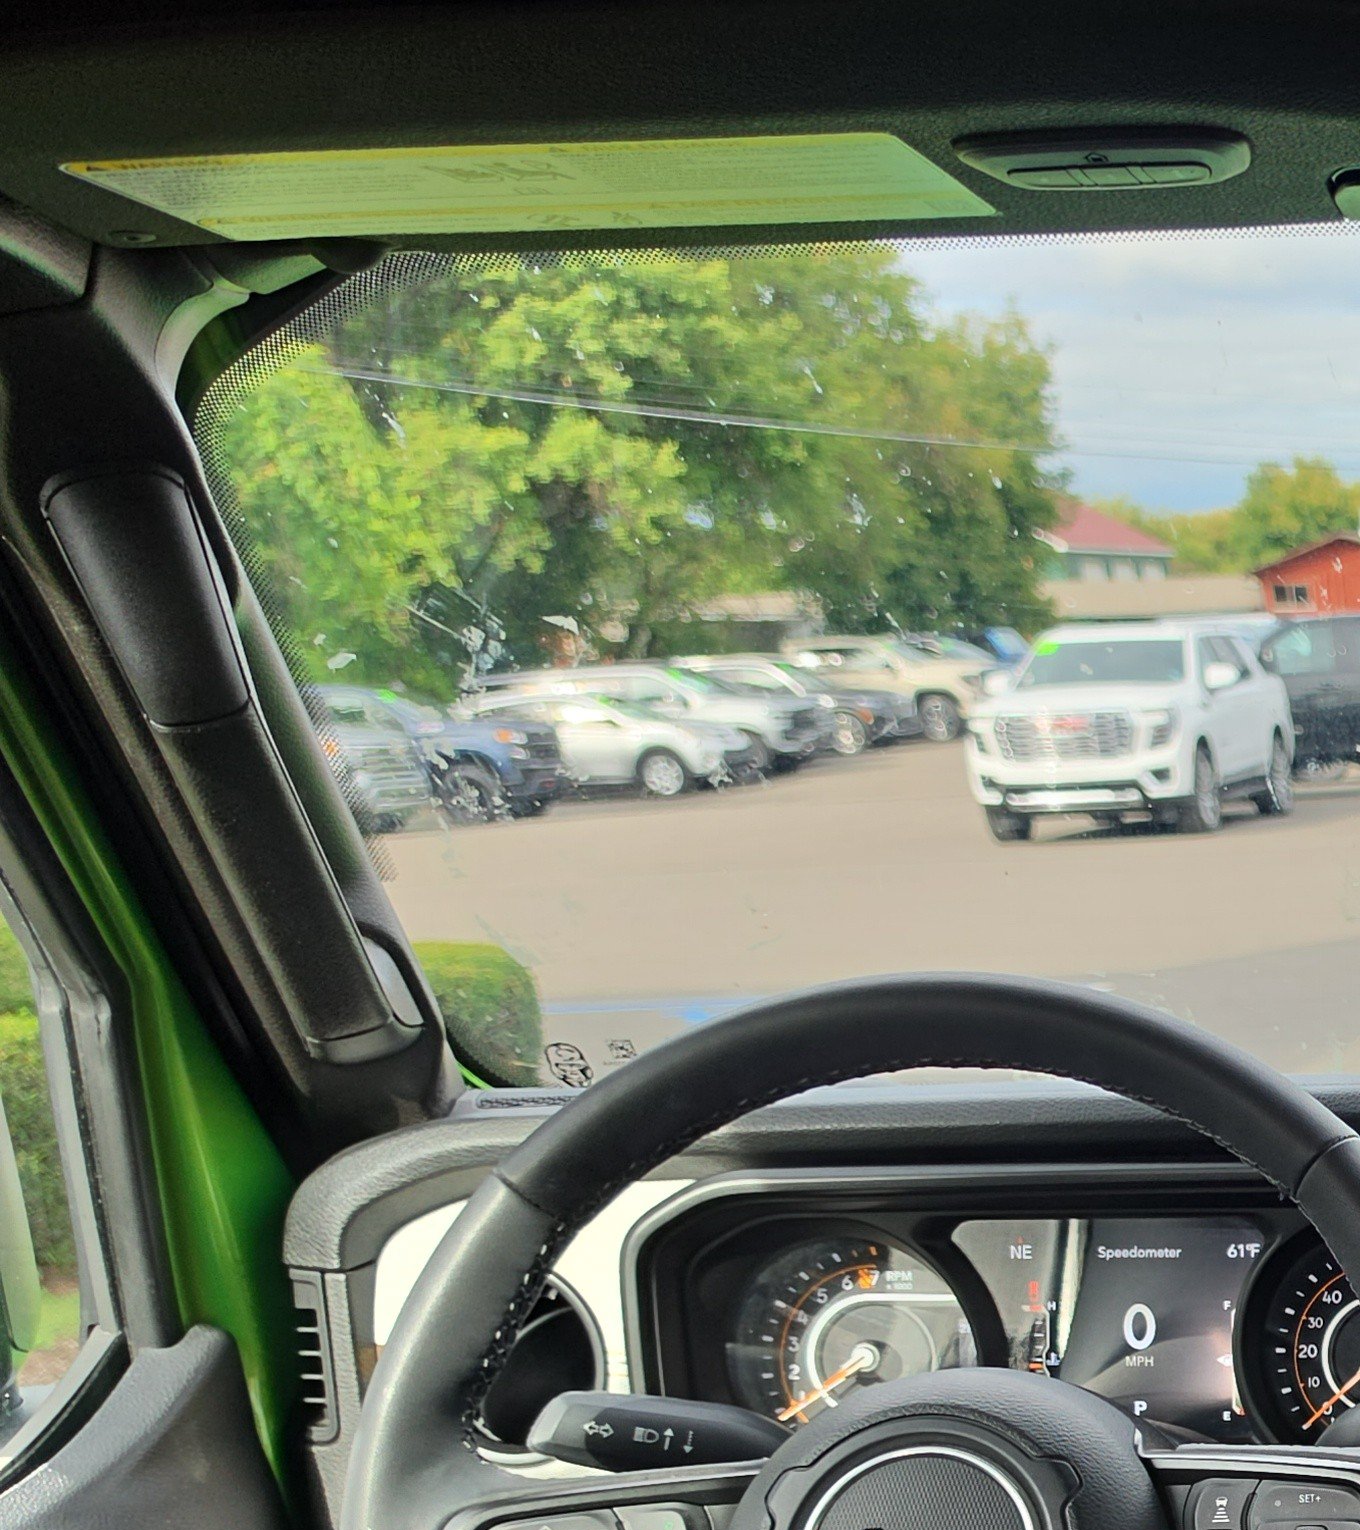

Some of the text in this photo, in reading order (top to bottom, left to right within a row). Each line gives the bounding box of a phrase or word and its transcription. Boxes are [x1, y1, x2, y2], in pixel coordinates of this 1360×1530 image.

[1009, 1245, 1034, 1260] NE
[1097, 1245, 1183, 1261] Speedometer
[841, 1275, 854, 1291] 6
[885, 1270, 913, 1282] RPM
[816, 1288, 828, 1304] 5
[1321, 1290, 1343, 1304] 40
[1046, 1301, 1057, 1311] H
[1223, 1300, 1232, 1311] F
[797, 1311, 809, 1326] 4
[1307, 1316, 1324, 1330] 30
[1123, 1303, 1157, 1351] 0
[788, 1335, 800, 1352] 3
[1298, 1344, 1318, 1359] 20
[1124, 1356, 1155, 1367] MPH
[787, 1363, 801, 1381] 2
[1307, 1377, 1321, 1389] 10
[1134, 1400, 1148, 1417] P
[1222, 1410, 1232, 1421] E
